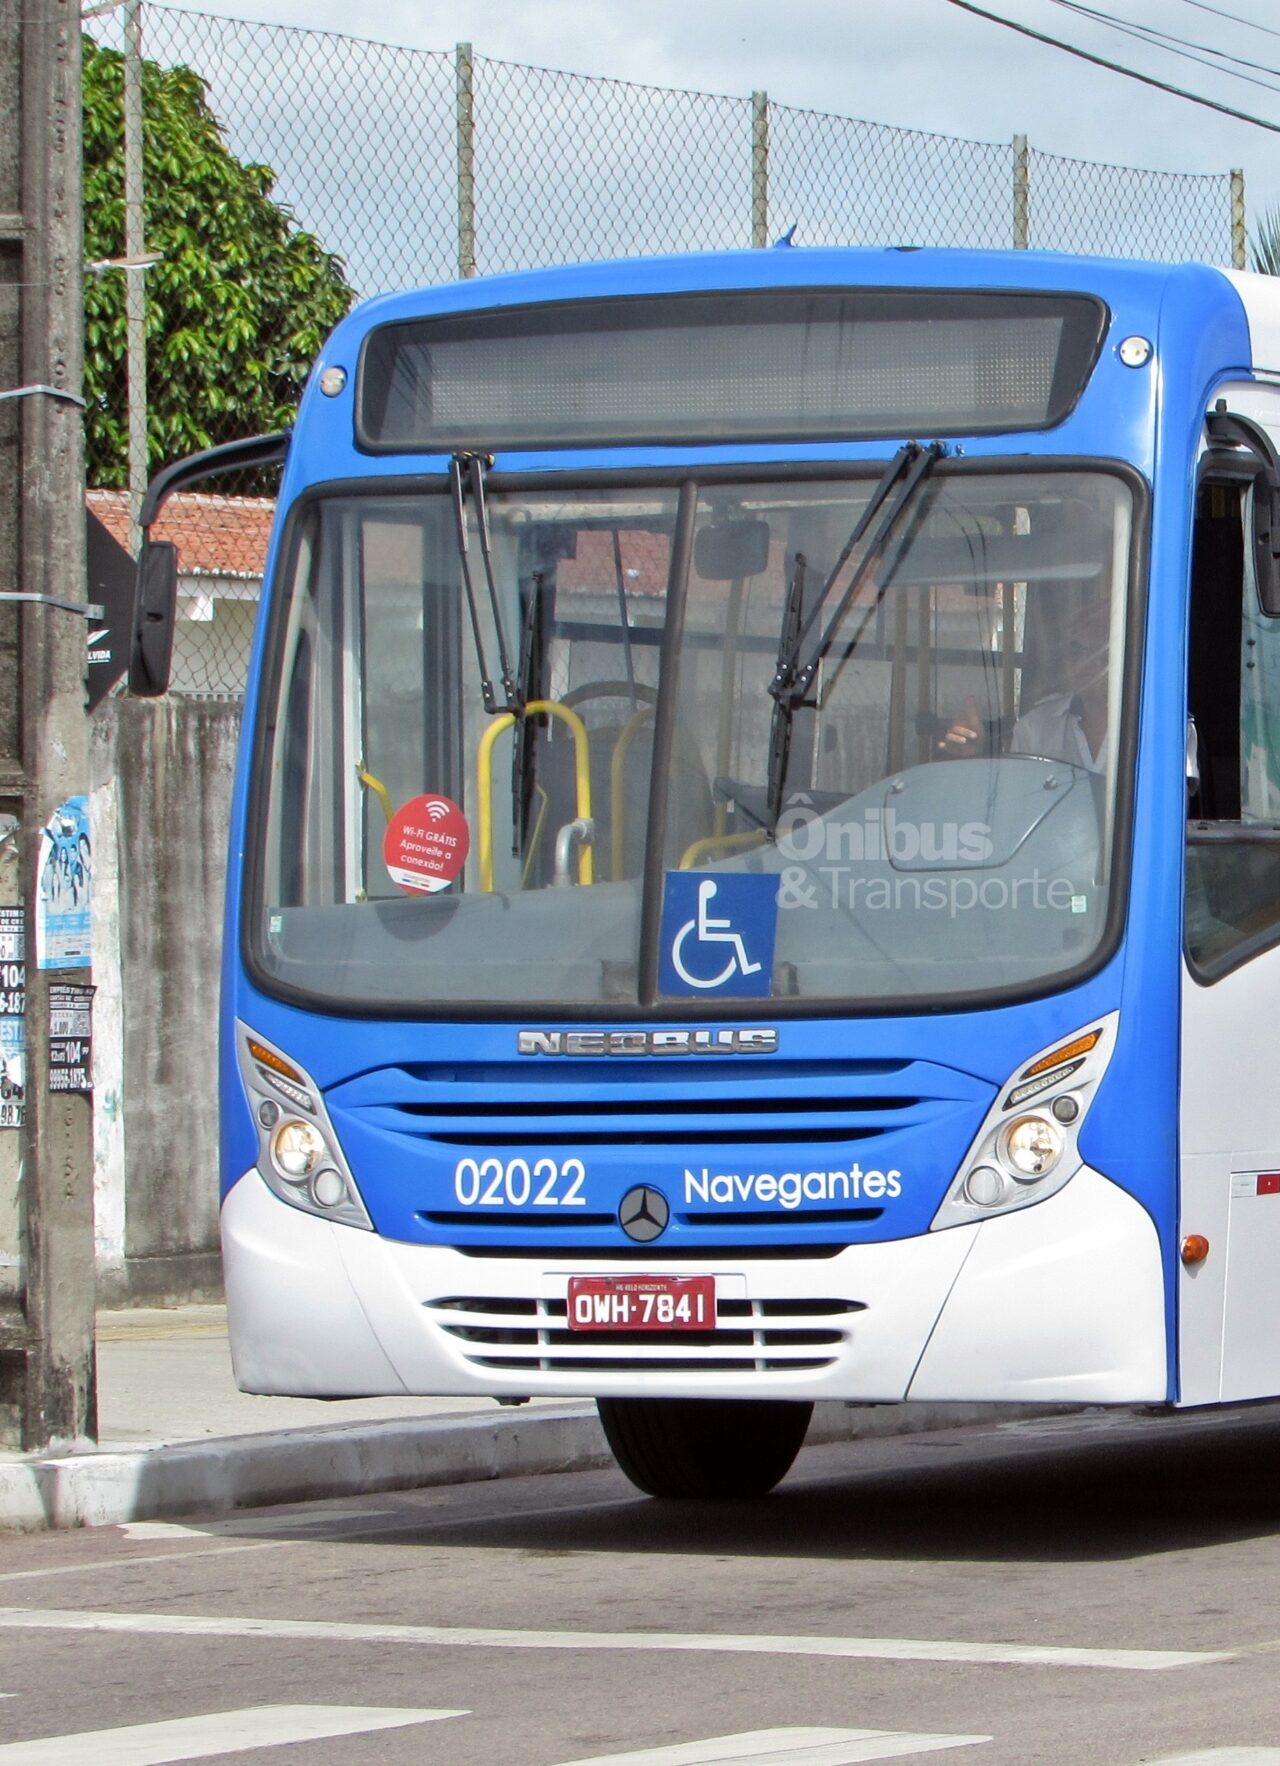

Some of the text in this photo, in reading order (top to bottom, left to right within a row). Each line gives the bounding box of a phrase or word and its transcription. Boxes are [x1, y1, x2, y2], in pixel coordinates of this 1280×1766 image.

[402, 826, 457, 847] Wi-Fi GRÁTIS
[400, 839, 452, 860] Aproveite a
[400, 855, 444, 871] conexão!
[517, 1027, 779, 1057] NEOBUS
[454, 1158, 586, 1206] 02022
[685, 1163, 902, 1209] Navegantes
